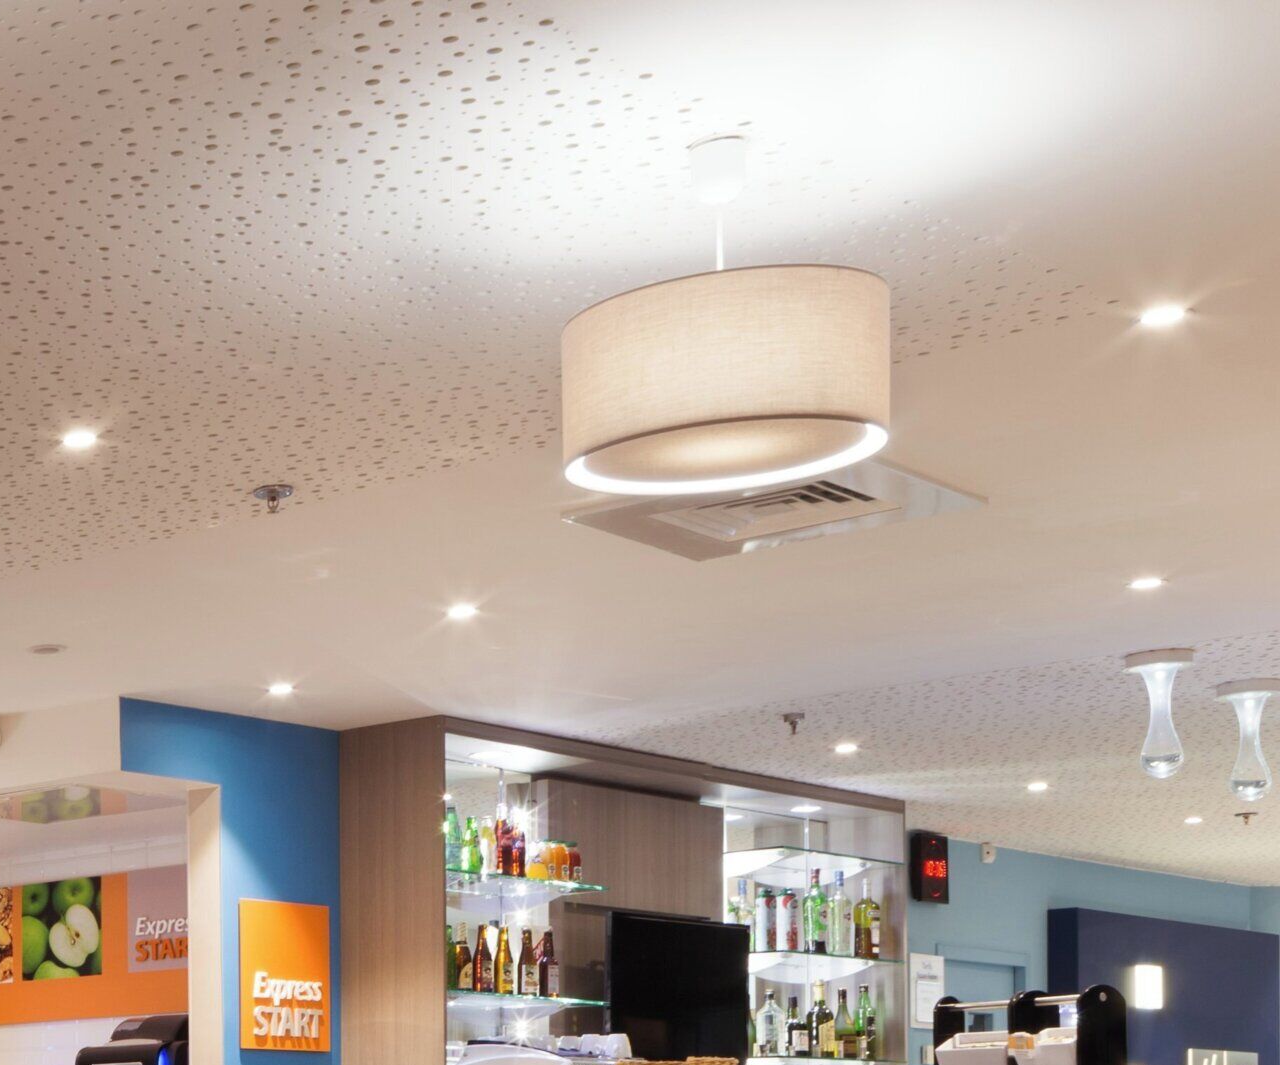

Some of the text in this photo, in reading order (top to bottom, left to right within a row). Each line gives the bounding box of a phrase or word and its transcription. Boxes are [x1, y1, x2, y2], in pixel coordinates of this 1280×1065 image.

[135, 917, 188, 939] Expre
[135, 937, 188, 962] STAR
[253, 971, 322, 1006] Express
[253, 1005, 323, 1039] START
